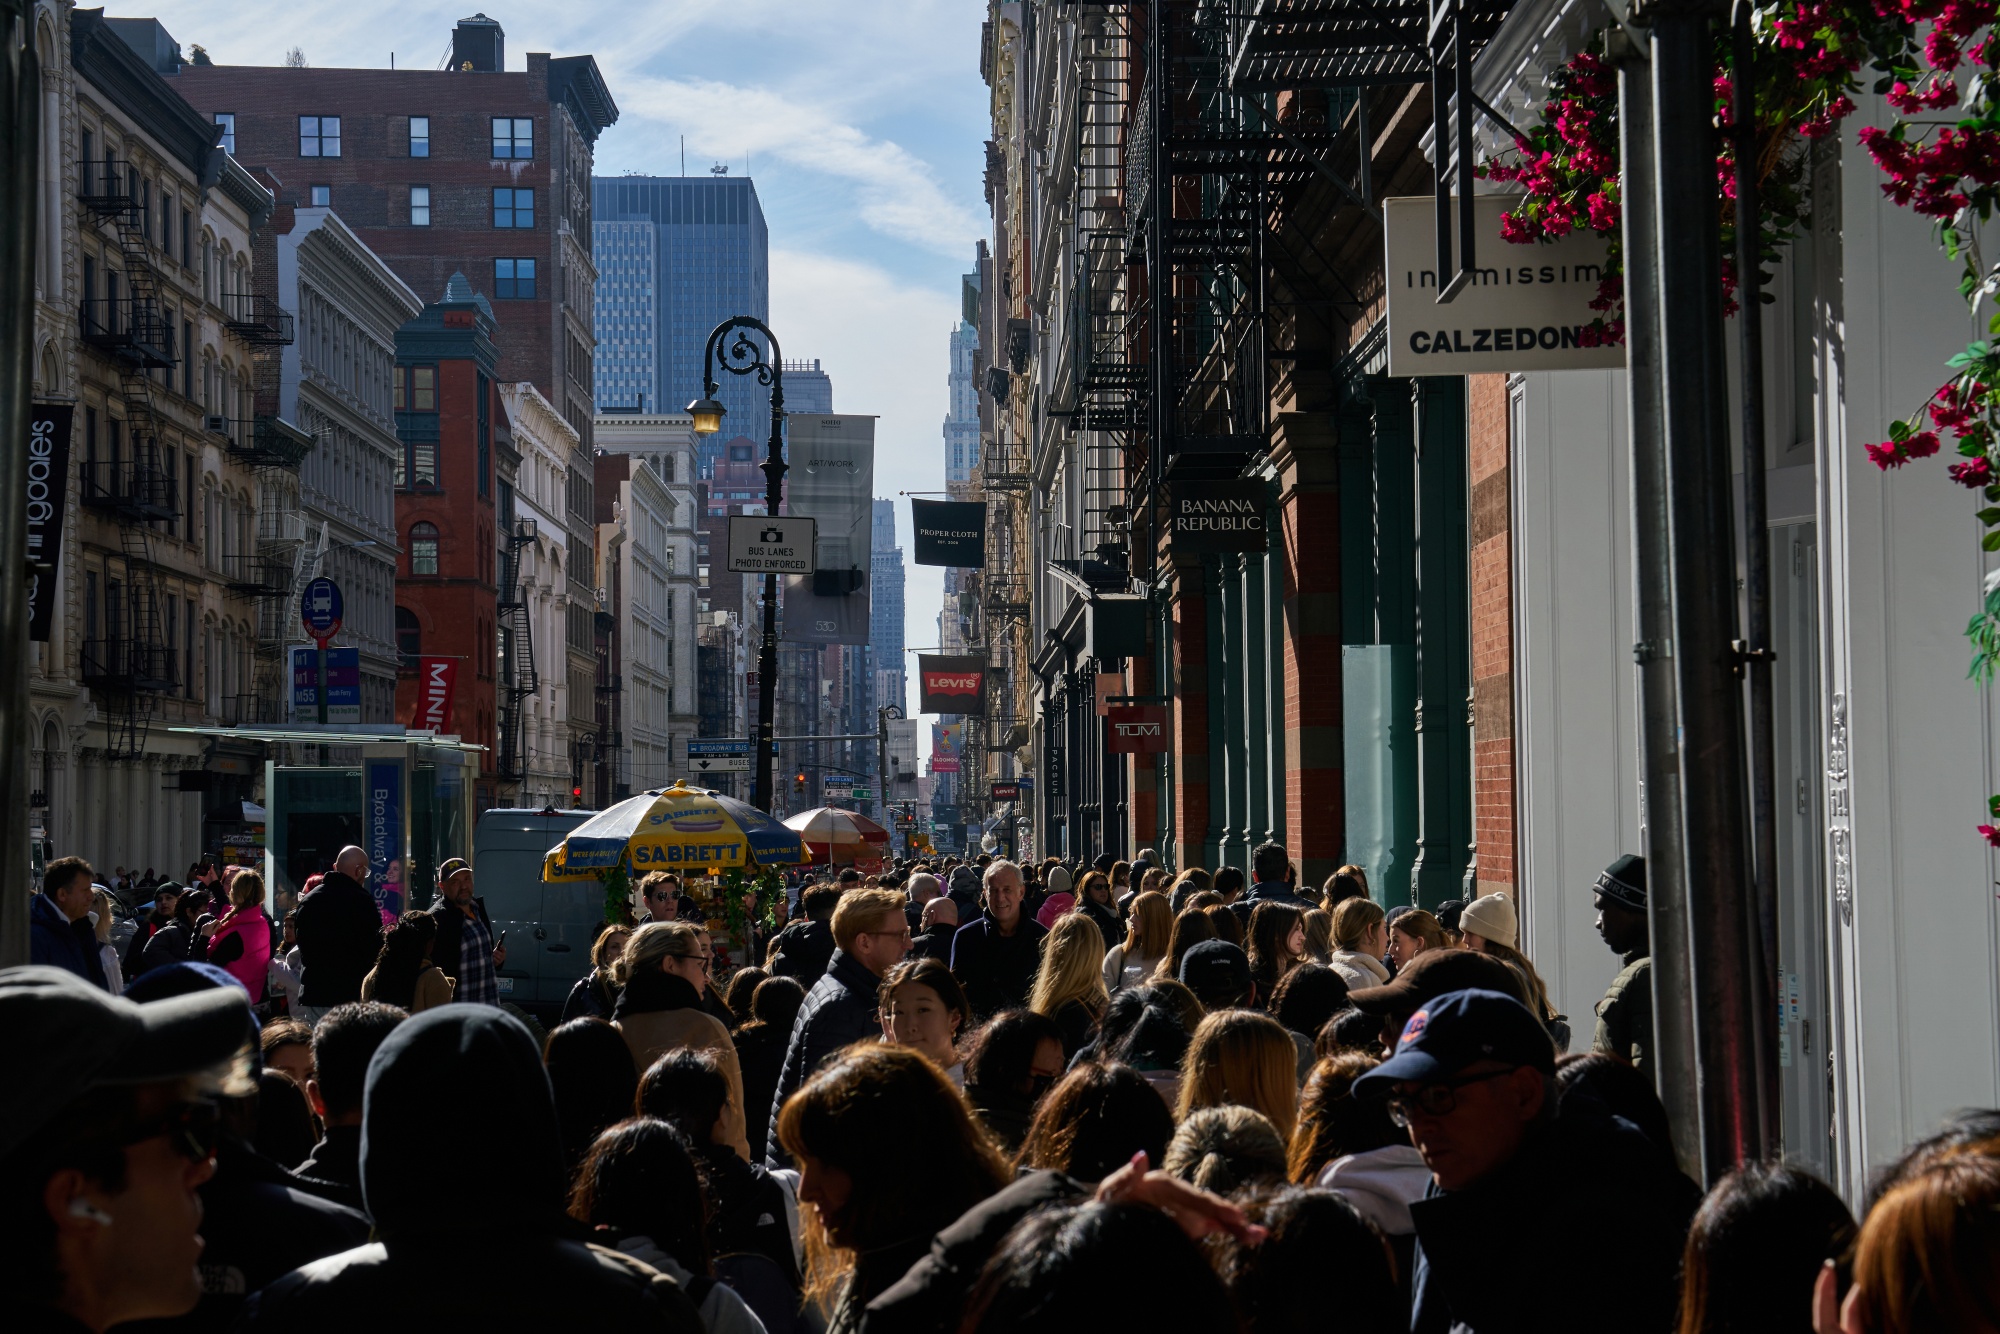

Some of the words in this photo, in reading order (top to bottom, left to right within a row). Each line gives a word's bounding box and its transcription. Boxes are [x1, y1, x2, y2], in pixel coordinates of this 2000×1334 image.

[1407, 264, 1601, 288] inmissim
[1409, 326, 1615, 354] CALZEDON
[807, 460, 854, 468] ART/WORK
[1181, 499, 1255, 513] BANANA
[1177, 516, 1261, 531] REPUBLIC
[920, 528, 950, 537] PROPER
[748, 547, 764, 556] BUS
[767, 547, 794, 556] LANES
[735, 559, 762, 568] PHOTO
[764, 560, 806, 569] ENFORCED
[305, 622, 313, 633] NO
[313, 621, 339, 637] STANDING
[295, 652, 307, 666] M1
[296, 670, 308, 684] M1
[296, 689, 315, 702] M55
[425, 663, 449, 735] MINIS
[1114, 722, 1160, 737] TUMI
[650, 808, 719, 826] SABRETT
[371, 788, 388, 868] Broadway
[228, 835, 252, 843] Coffee
[635, 843, 741, 864] SABRETT
[374, 871, 388, 883] &
[1601, 875, 1630, 898] YORK
